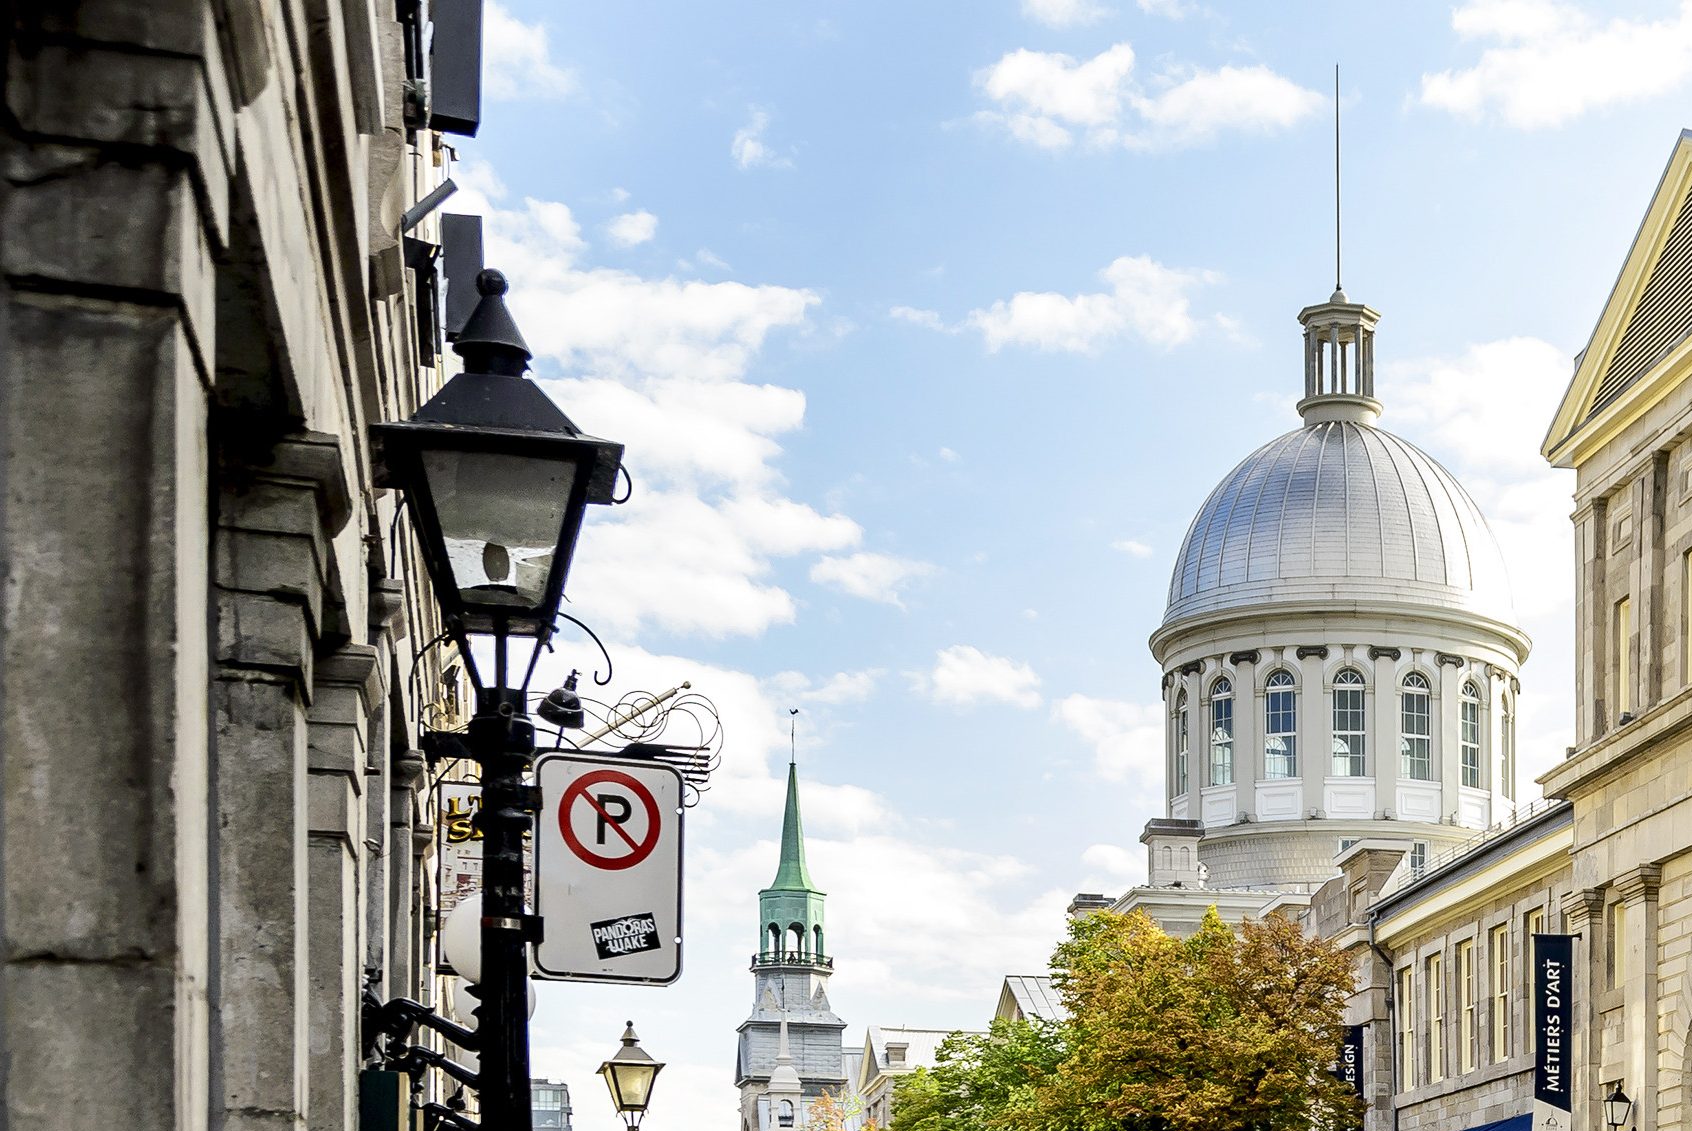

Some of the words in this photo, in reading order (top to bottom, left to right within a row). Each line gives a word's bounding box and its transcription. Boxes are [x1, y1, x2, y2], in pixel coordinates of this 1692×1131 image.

[606, 934, 649, 953] WAKE
[1545, 958, 1561, 1008] D'ART
[1544, 1014, 1561, 1092] MÉTIERS
